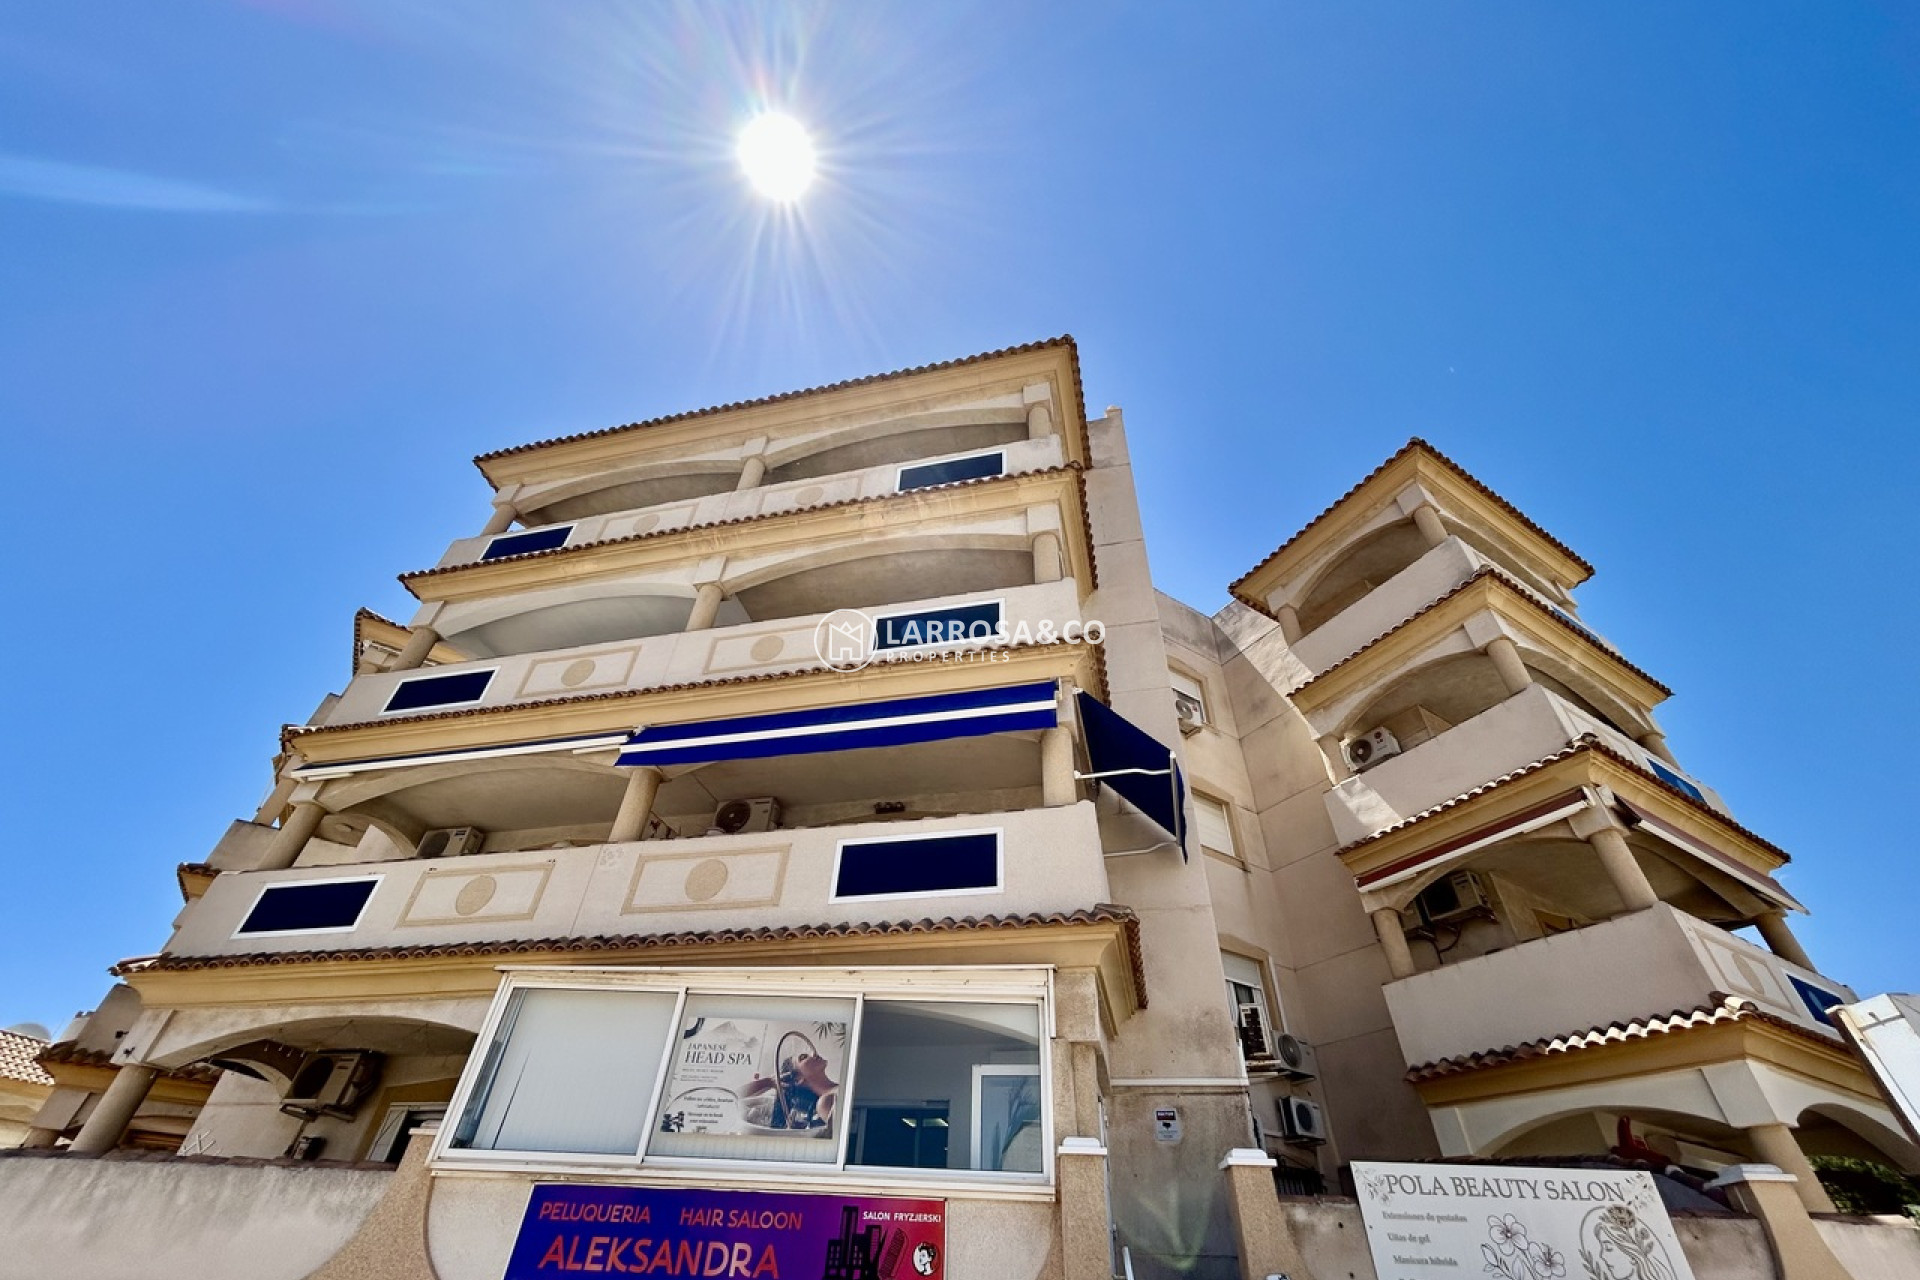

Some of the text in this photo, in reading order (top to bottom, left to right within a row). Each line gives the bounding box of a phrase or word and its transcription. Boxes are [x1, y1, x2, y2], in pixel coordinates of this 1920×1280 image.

[688, 1043, 727, 1051] JAPANESE
[685, 1051, 752, 1065] HEAD SPA
[1384, 1174, 1626, 1202] POLA BEAUTY SALON
[539, 1201, 803, 1230] PELUQUERIA HAIR SALOON
[862, 1211, 941, 1223] SALON FRYZJERSKI
[1425, 1212, 1435, 1222] de
[1407, 1233, 1417, 1243] de
[537, 1234, 780, 1280] ALEKSANDRA
